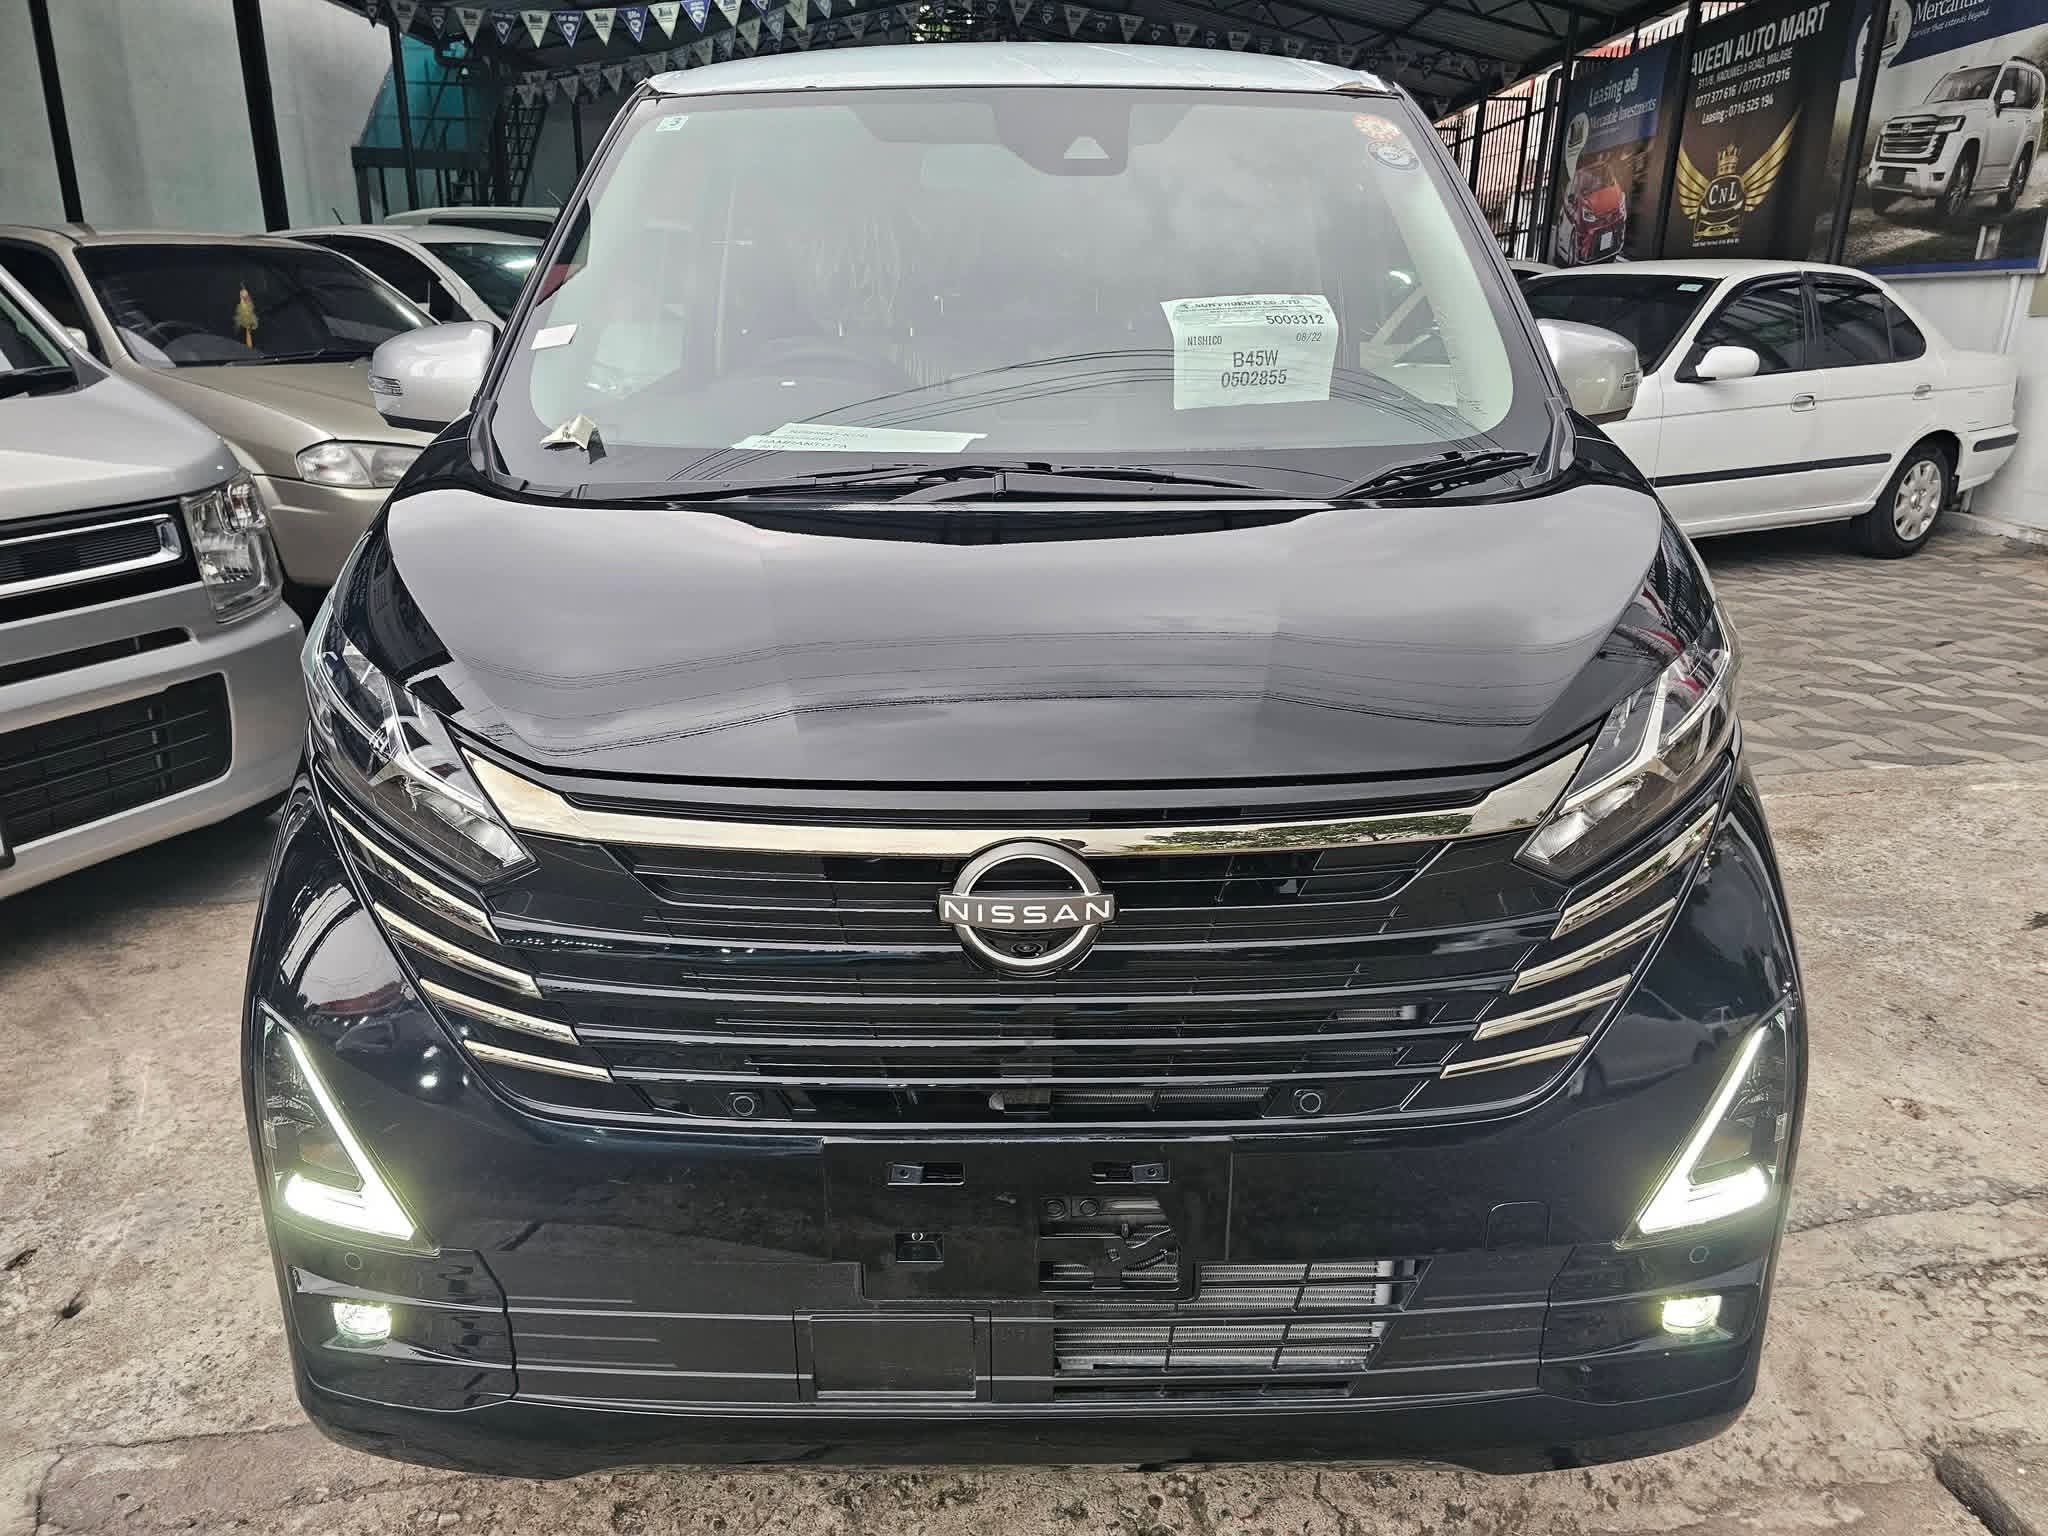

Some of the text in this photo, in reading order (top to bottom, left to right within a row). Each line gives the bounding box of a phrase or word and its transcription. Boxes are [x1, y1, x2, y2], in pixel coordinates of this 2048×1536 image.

[1914, 0, 1986, 25] Mercan
[1734, 22, 1777, 61] AUTO
[1778, 1, 1831, 46] MART
[1266, 314, 1324, 325] 5003312
[1296, 332, 1322, 343] 08/22
[1233, 350, 1279, 368] B45W
[1221, 369, 1287, 388] 0502855
[944, 900, 1110, 924] NISSAN
